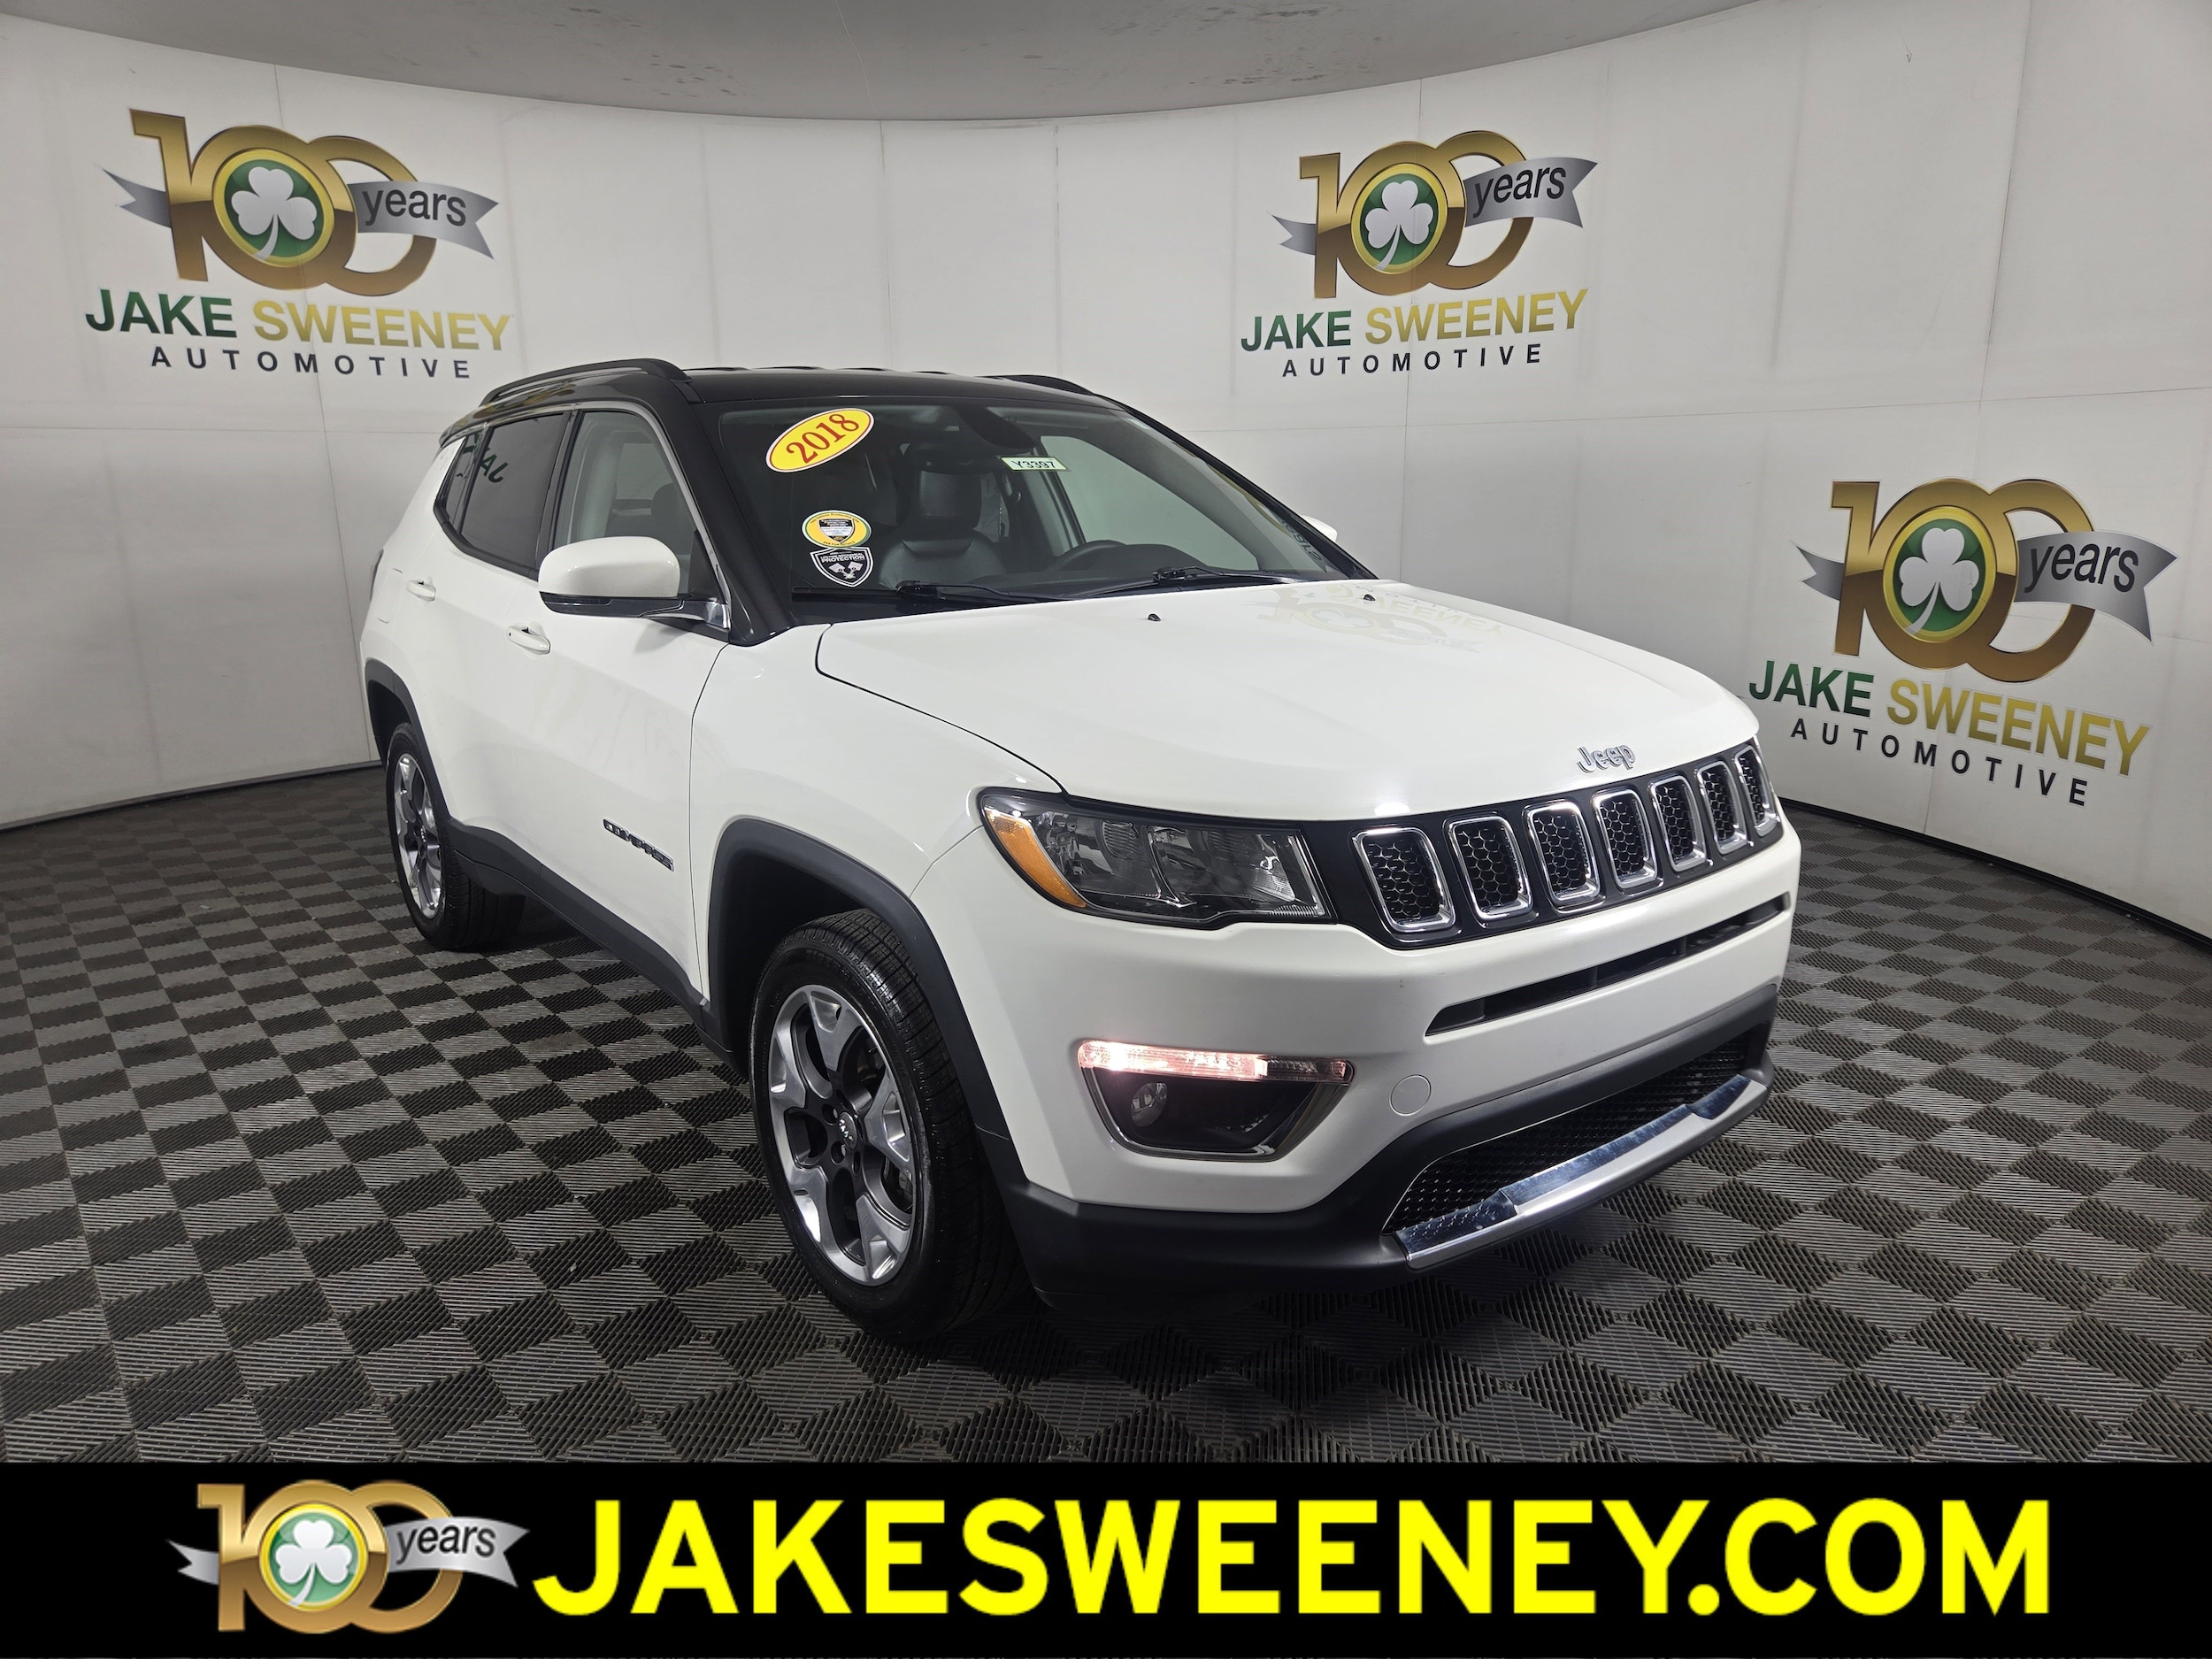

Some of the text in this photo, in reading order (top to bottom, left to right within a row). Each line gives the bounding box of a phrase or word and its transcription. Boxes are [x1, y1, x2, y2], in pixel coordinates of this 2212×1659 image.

[129, 108, 467, 296] 100 years
[1299, 130, 1567, 299] 100 years
[86, 288, 511, 350] JAKE SWEENEY
[1240, 288, 1589, 352] JAKE SWEENEY
[150, 346, 470, 379] AUTOMOTIVE
[1282, 343, 1540, 378] AUTOMOTIVE
[786, 413, 859, 464] 2018
[1011, 460, 1056, 469] Y3397
[1831, 478, 2139, 682] 100 years
[1748, 660, 2150, 776] JAKE SWEENEY
[1577, 744, 1636, 773] Jeep
[1791, 718, 2087, 807] AUTOMOTIVE
